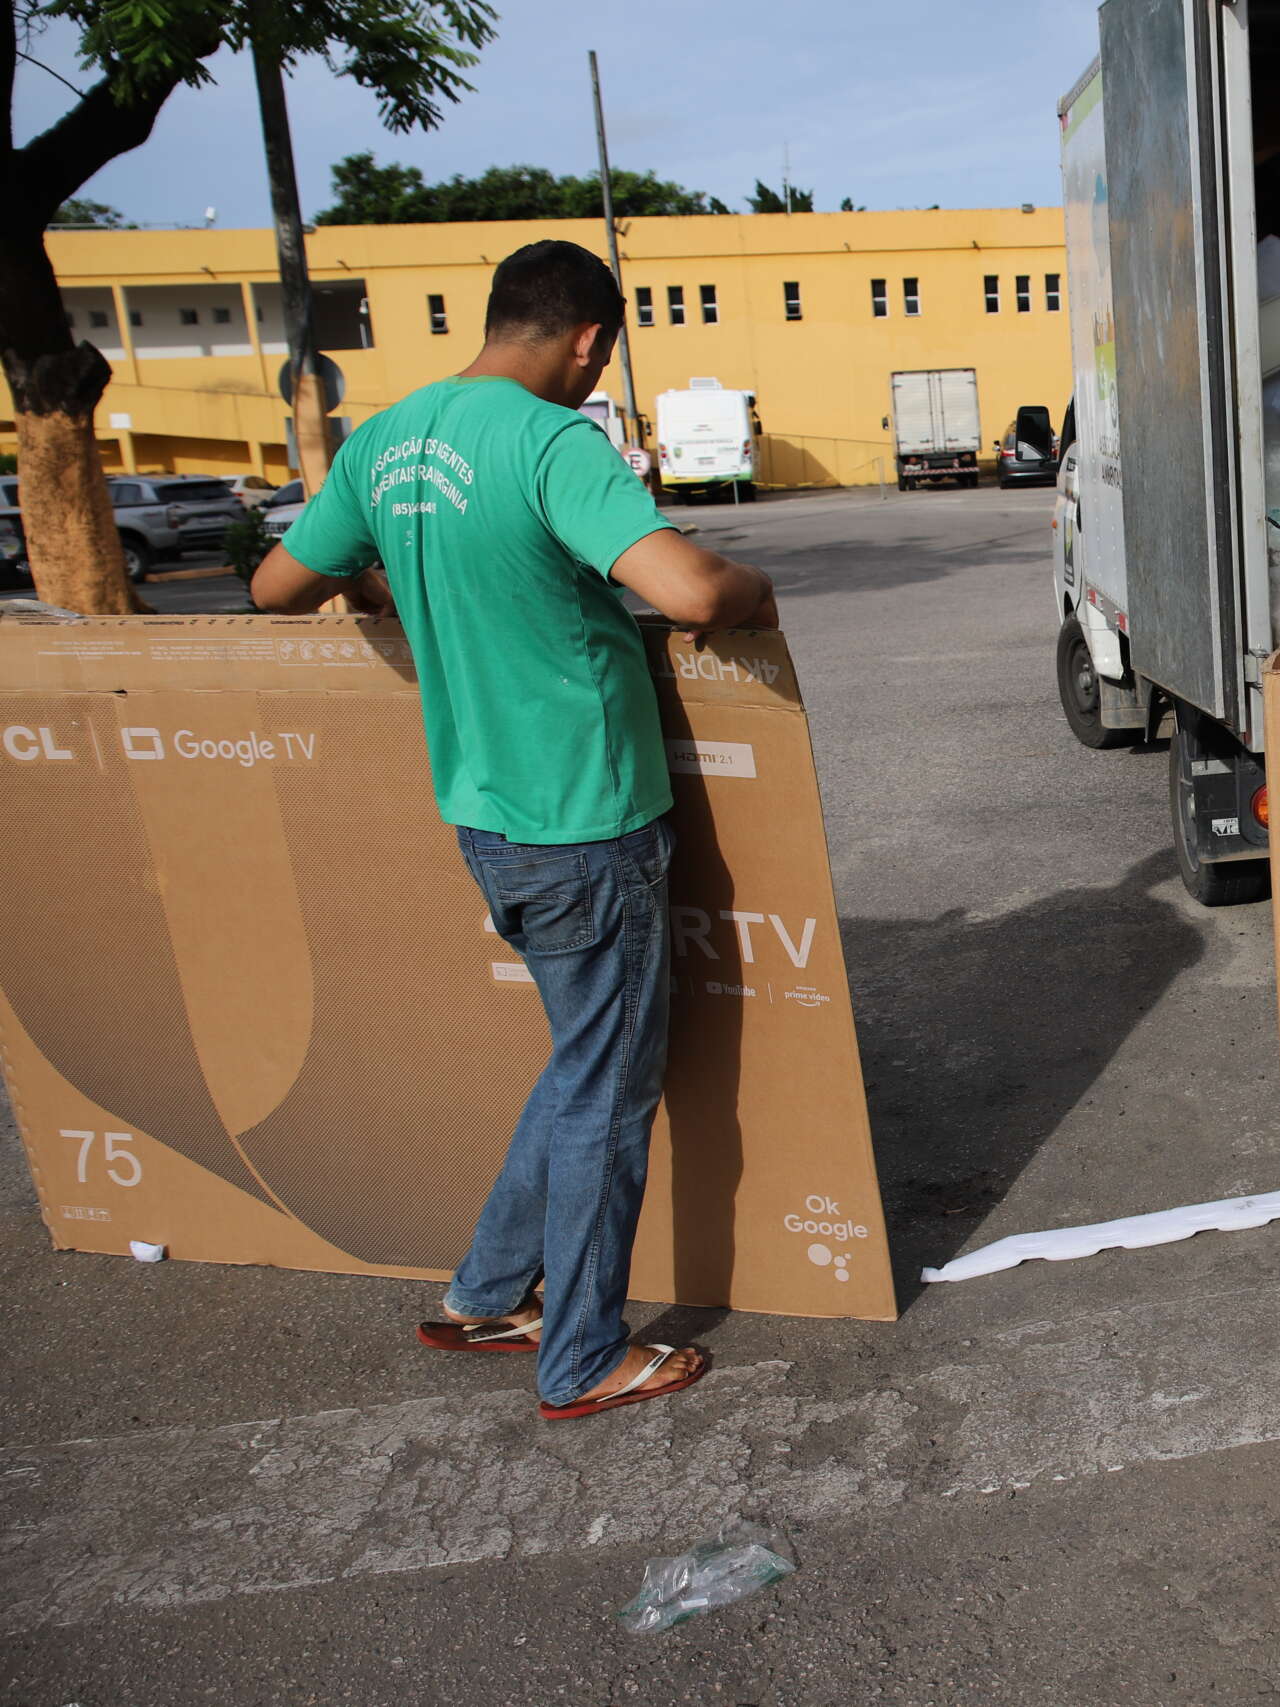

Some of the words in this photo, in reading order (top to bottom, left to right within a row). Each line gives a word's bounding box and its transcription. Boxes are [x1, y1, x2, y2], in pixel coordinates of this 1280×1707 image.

[740, 656, 782, 685] 4K
[0, 725, 73, 761] CL
[173, 729, 275, 767] Google
[277, 732, 316, 760] TV
[674, 751, 717, 764] HDMI
[719, 754, 733, 765] 2.1
[723, 983, 757, 998] YouTube
[59, 1129, 142, 1187] 75
[805, 1194, 841, 1216] Ok
[783, 1213, 868, 1242] Google
